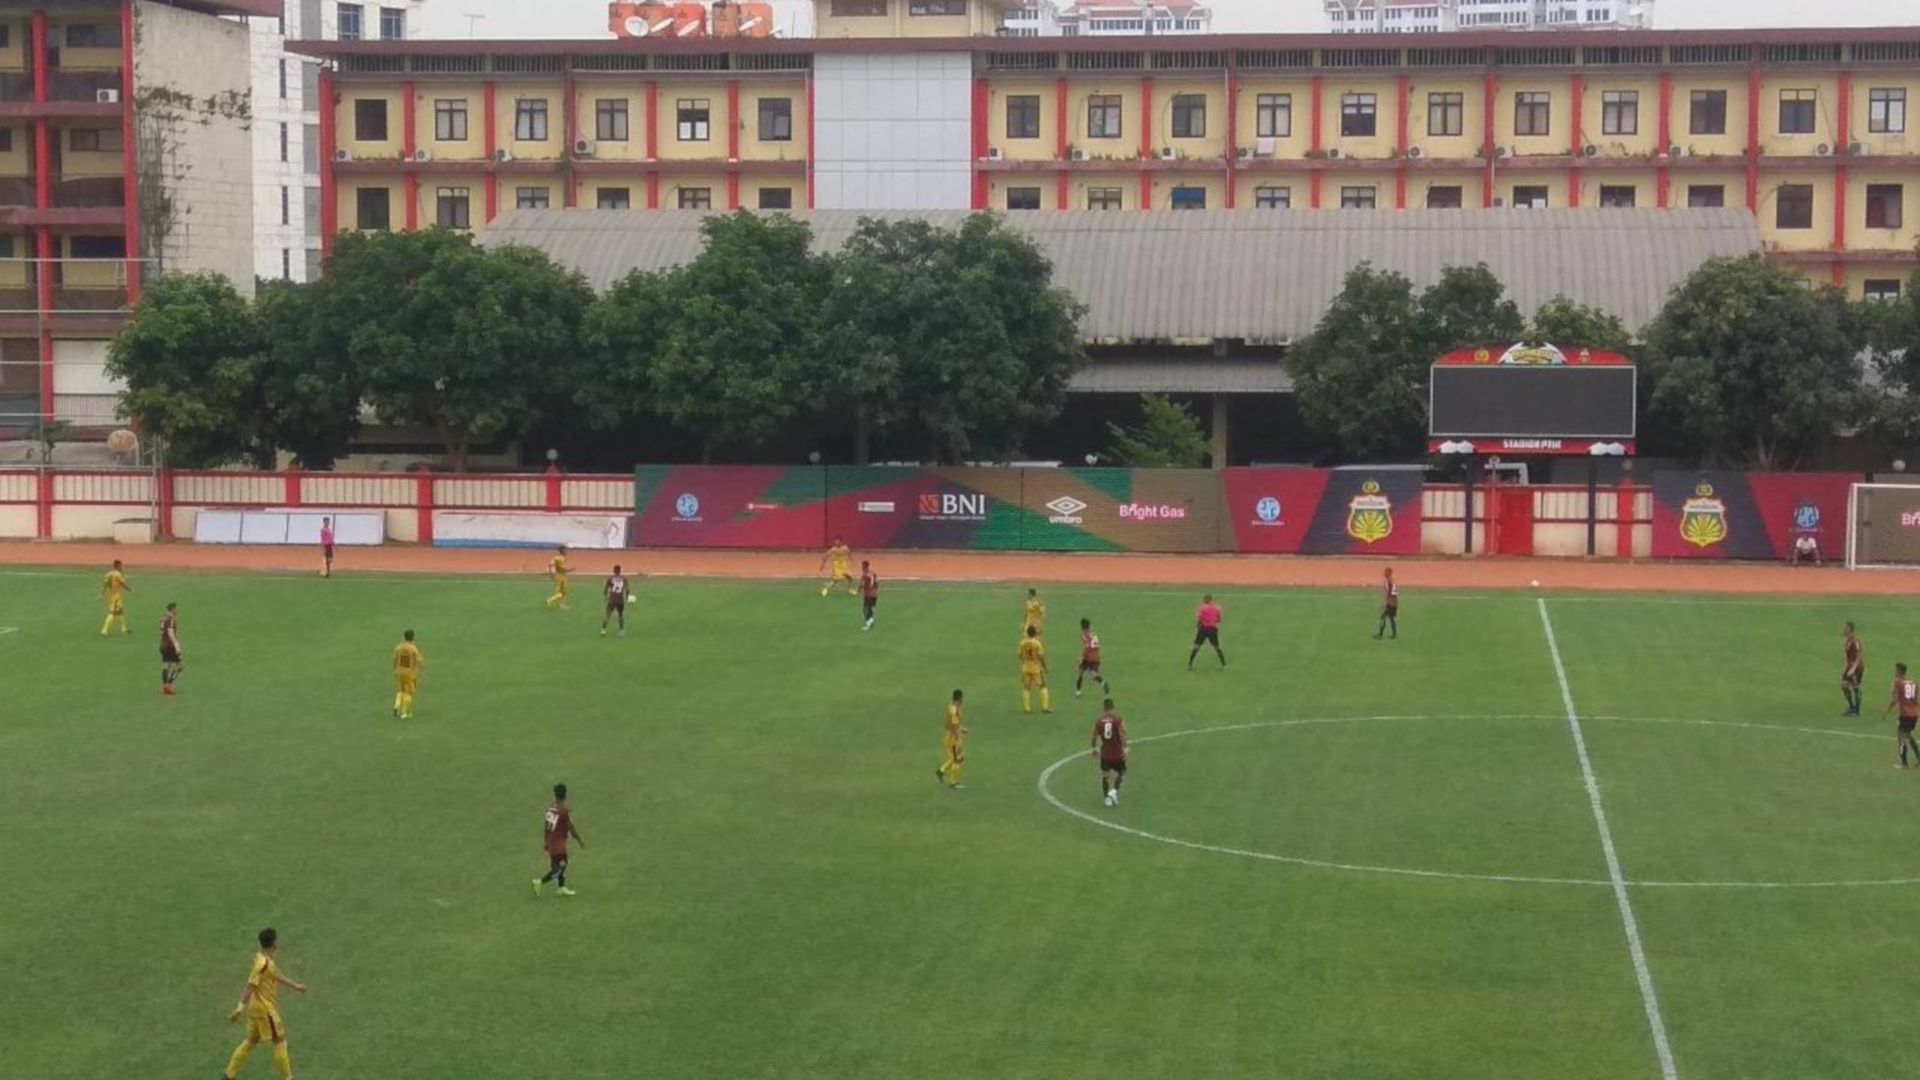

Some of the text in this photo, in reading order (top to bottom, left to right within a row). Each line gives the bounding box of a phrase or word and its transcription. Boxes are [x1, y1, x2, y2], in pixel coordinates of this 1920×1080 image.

[942, 494, 985, 515] BNI
[1119, 504, 1185, 521] Bright Gas
[1049, 516, 1083, 525] umbro
[1103, 722, 1113, 740] 8
